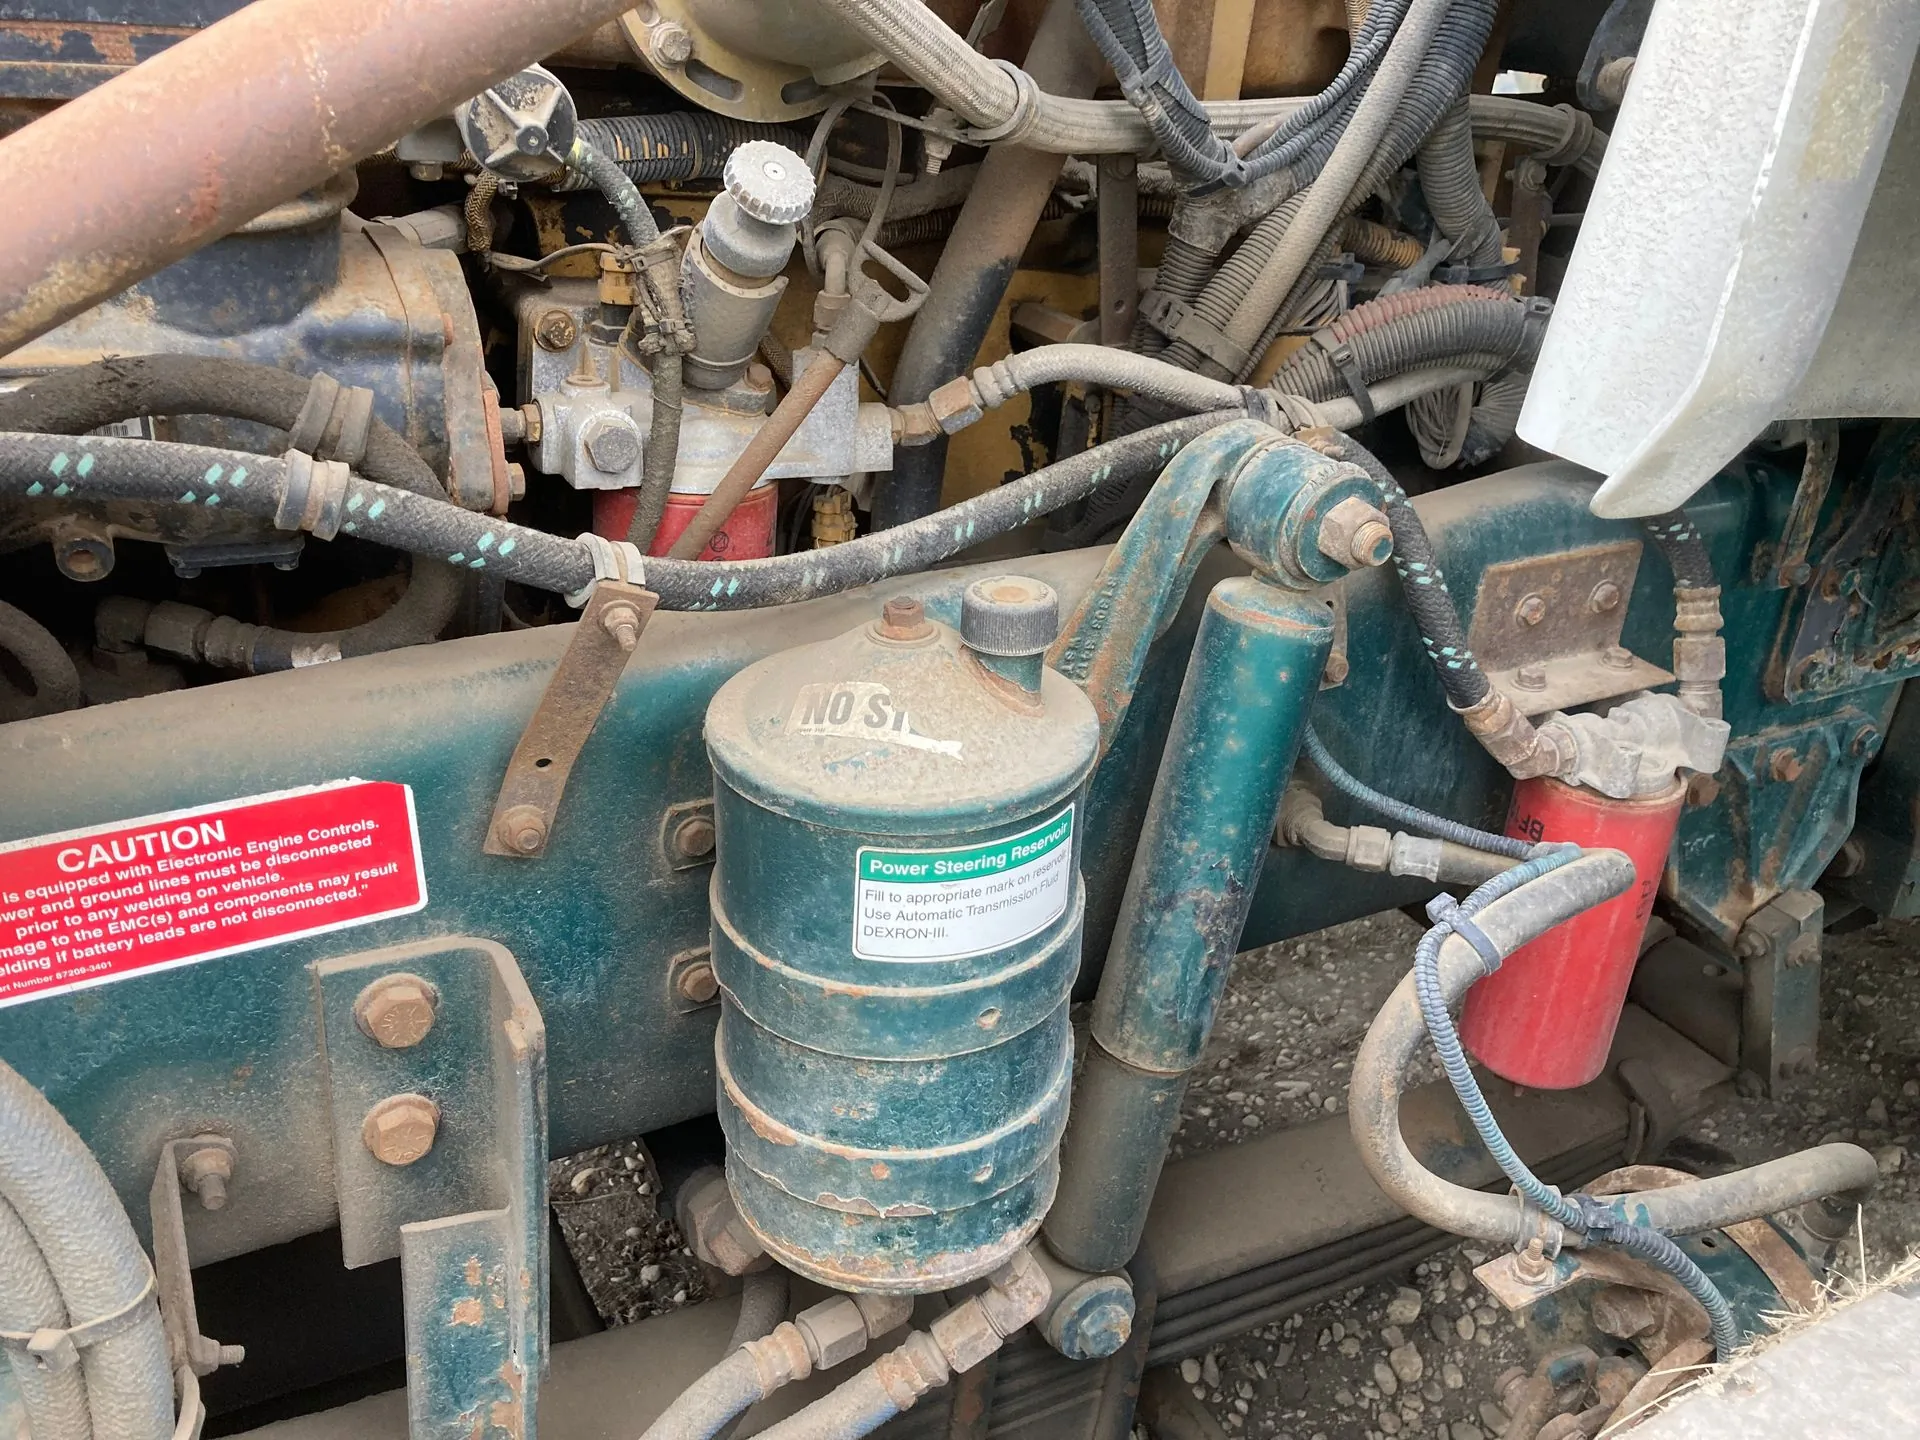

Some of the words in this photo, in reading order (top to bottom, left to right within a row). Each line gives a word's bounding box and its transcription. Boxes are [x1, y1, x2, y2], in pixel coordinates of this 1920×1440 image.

[801, 691, 855, 725] NO
[2, 892, 20, 904] is
[24, 872, 111, 899] equipped
[115, 863, 152, 881] with
[156, 846, 242, 873] Electronic
[246, 834, 303, 854] Engine
[307, 819, 379, 841] Controls.
[57, 820, 226, 872] CAUTION
[870, 859, 929, 876] Power
[934, 853, 1007, 875] Steering
[1011, 822, 1068, 861] Reservoir
[0, 906, 35, 924] wer
[41, 896, 75, 914] and
[80, 882, 144, 909] ground
[148, 874, 191, 892] lines
[195, 863, 236, 882] must
[240, 860, 261, 872] be
[265, 835, 372, 867] disconnected
[51, 935, 70, 947] to
[74, 927, 103, 942] the
[107, 911, 173, 935] EMC(s)
[177, 902, 209, 920] and
[214, 882, 314, 911] components
[318, 874, 350, 889] may
[355, 862, 399, 881] result
[864, 906, 891, 920] Use
[895, 908, 963, 921] Automatic
[965, 886, 1038, 917] Transmission
[1039, 871, 1060, 892] Fluid
[865, 889, 884, 902] Fill
[889, 892, 902, 903] to
[906, 887, 982, 906] appropriate
[986, 877, 1015, 895] mark
[1017, 873, 1030, 885] on
[15, 920, 59, 941] prior
[63, 914, 82, 927] to
[87, 906, 119, 922] any
[124, 891, 192, 914] welding
[196, 885, 218, 899] on
[222, 872, 285, 893] vehicle.
[863, 925, 949, 940] DEXRON-III.
[55, 950, 68, 964] if
[72, 937, 133, 960] battery
[138, 926, 186, 945] leads
[190, 919, 217, 934] are
[221, 911, 248, 927] not
[12, 975, 54, 989] Number
